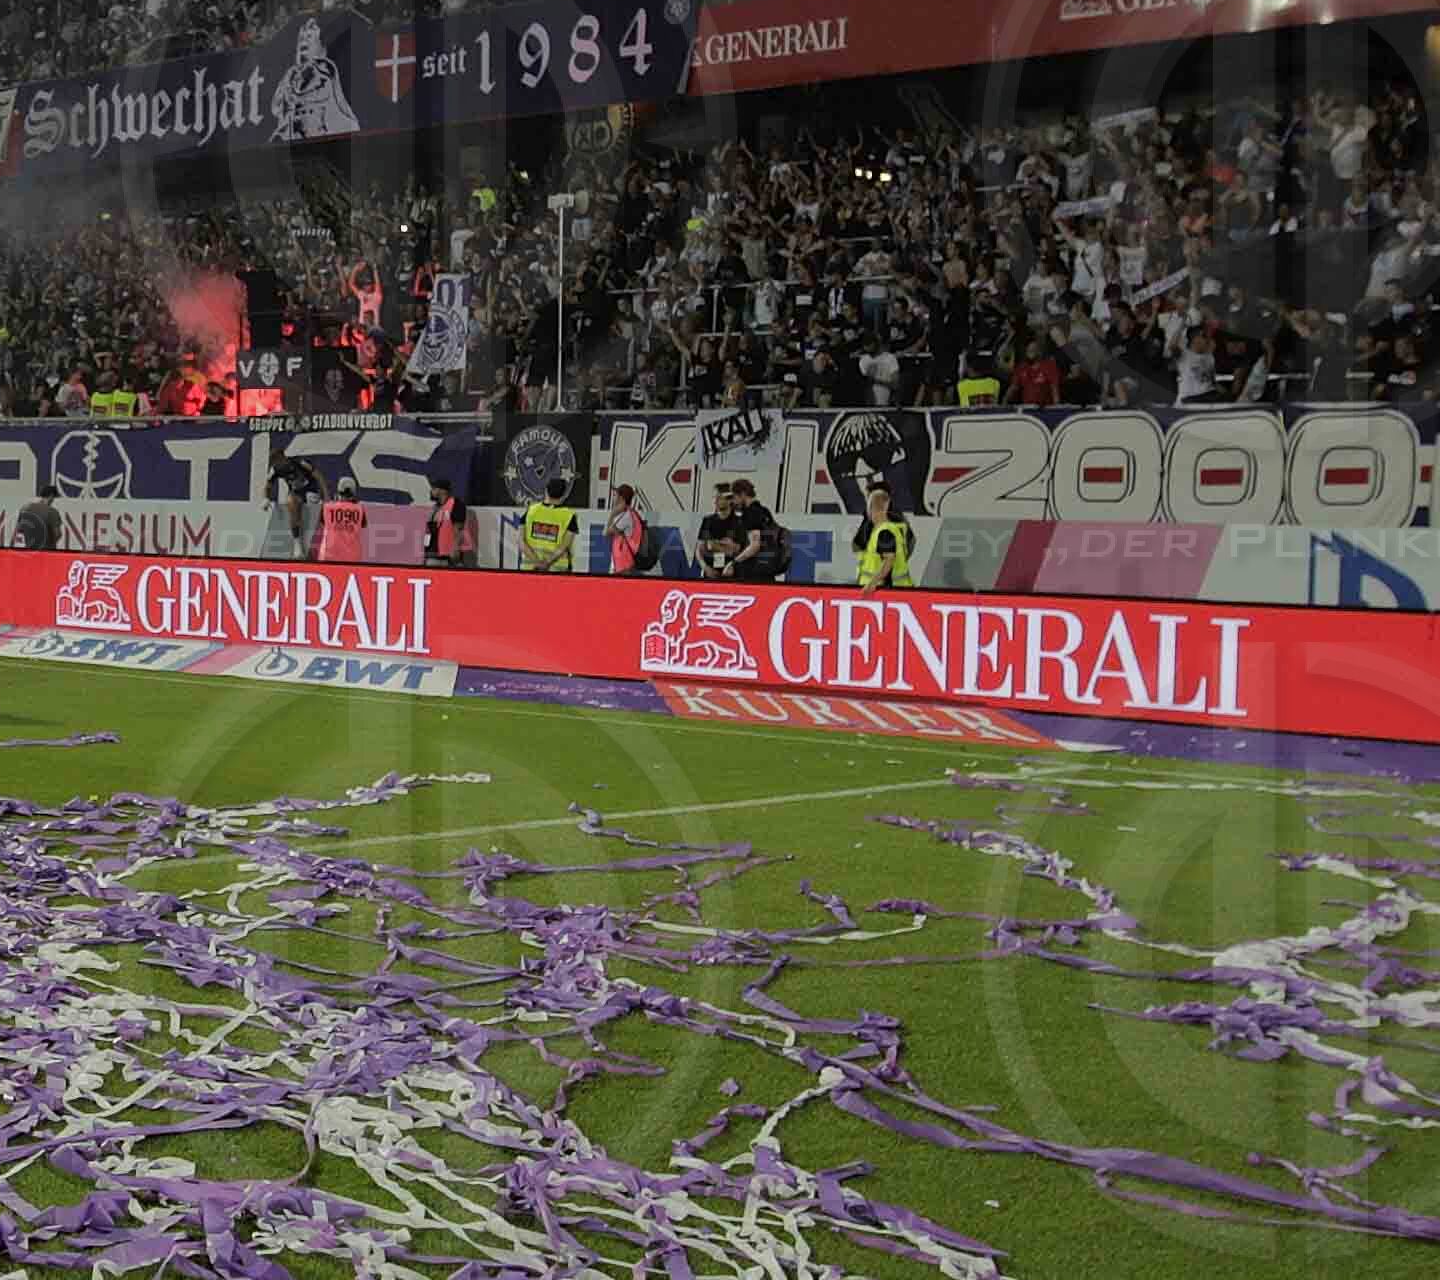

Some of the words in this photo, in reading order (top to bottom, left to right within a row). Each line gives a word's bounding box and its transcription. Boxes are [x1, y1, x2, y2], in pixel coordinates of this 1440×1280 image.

[705, 16, 849, 66] GENERALI
[22, 65, 266, 160] Schwechat
[473, 7, 654, 96] 1984
[134, 564, 433, 655] GENERALI
[298, 656, 436, 690] BWT
[767, 594, 1251, 718] GENERALI
[669, 684, 1041, 744] KURIER
